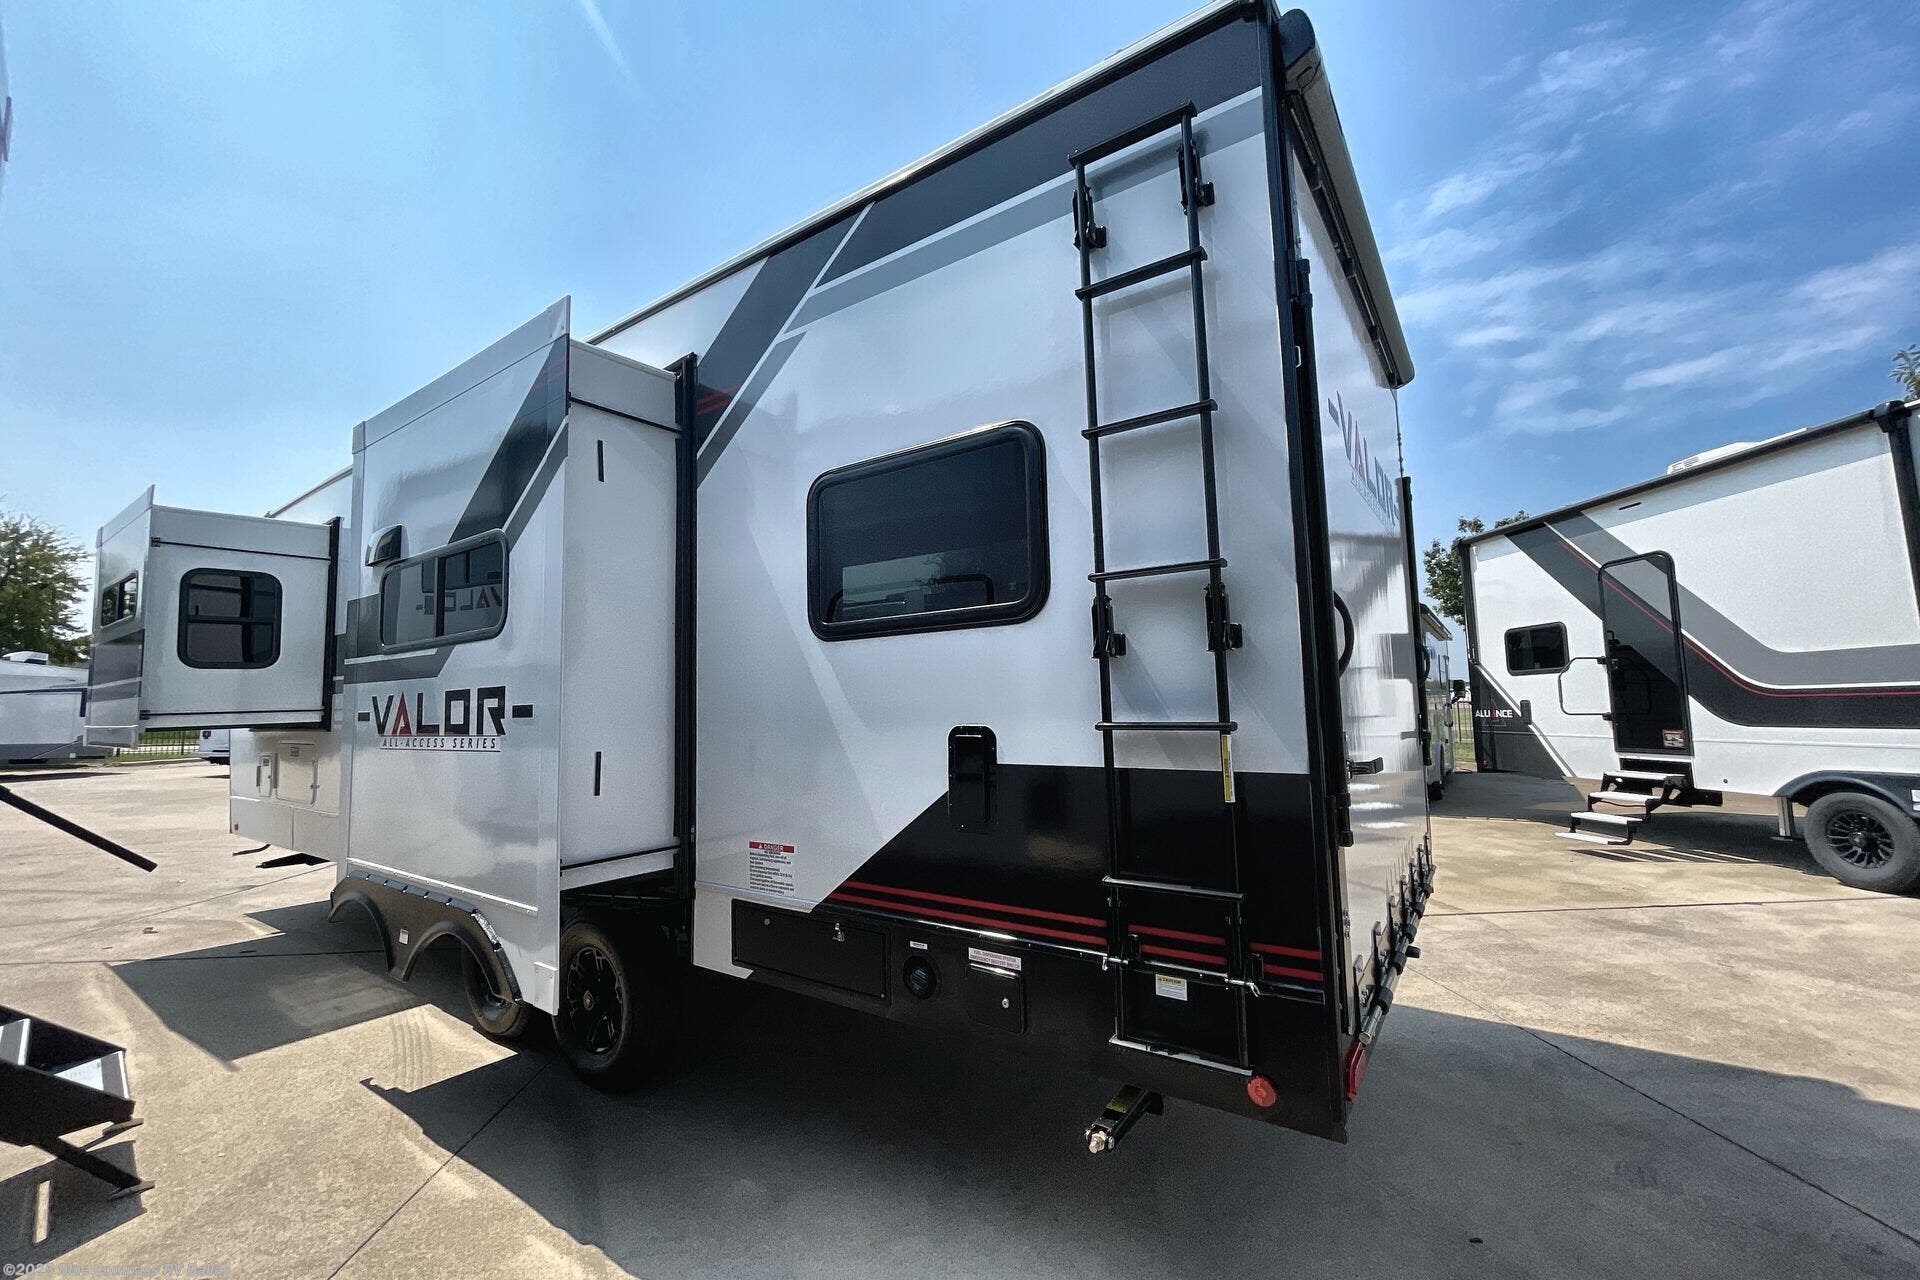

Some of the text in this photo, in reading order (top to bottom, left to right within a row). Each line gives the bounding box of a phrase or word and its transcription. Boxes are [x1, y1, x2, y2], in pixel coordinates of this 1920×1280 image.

[1475, 707, 1512, 718] ALLIANCE
[382, 737, 497, 749] ALL-ACCESS SERIES
